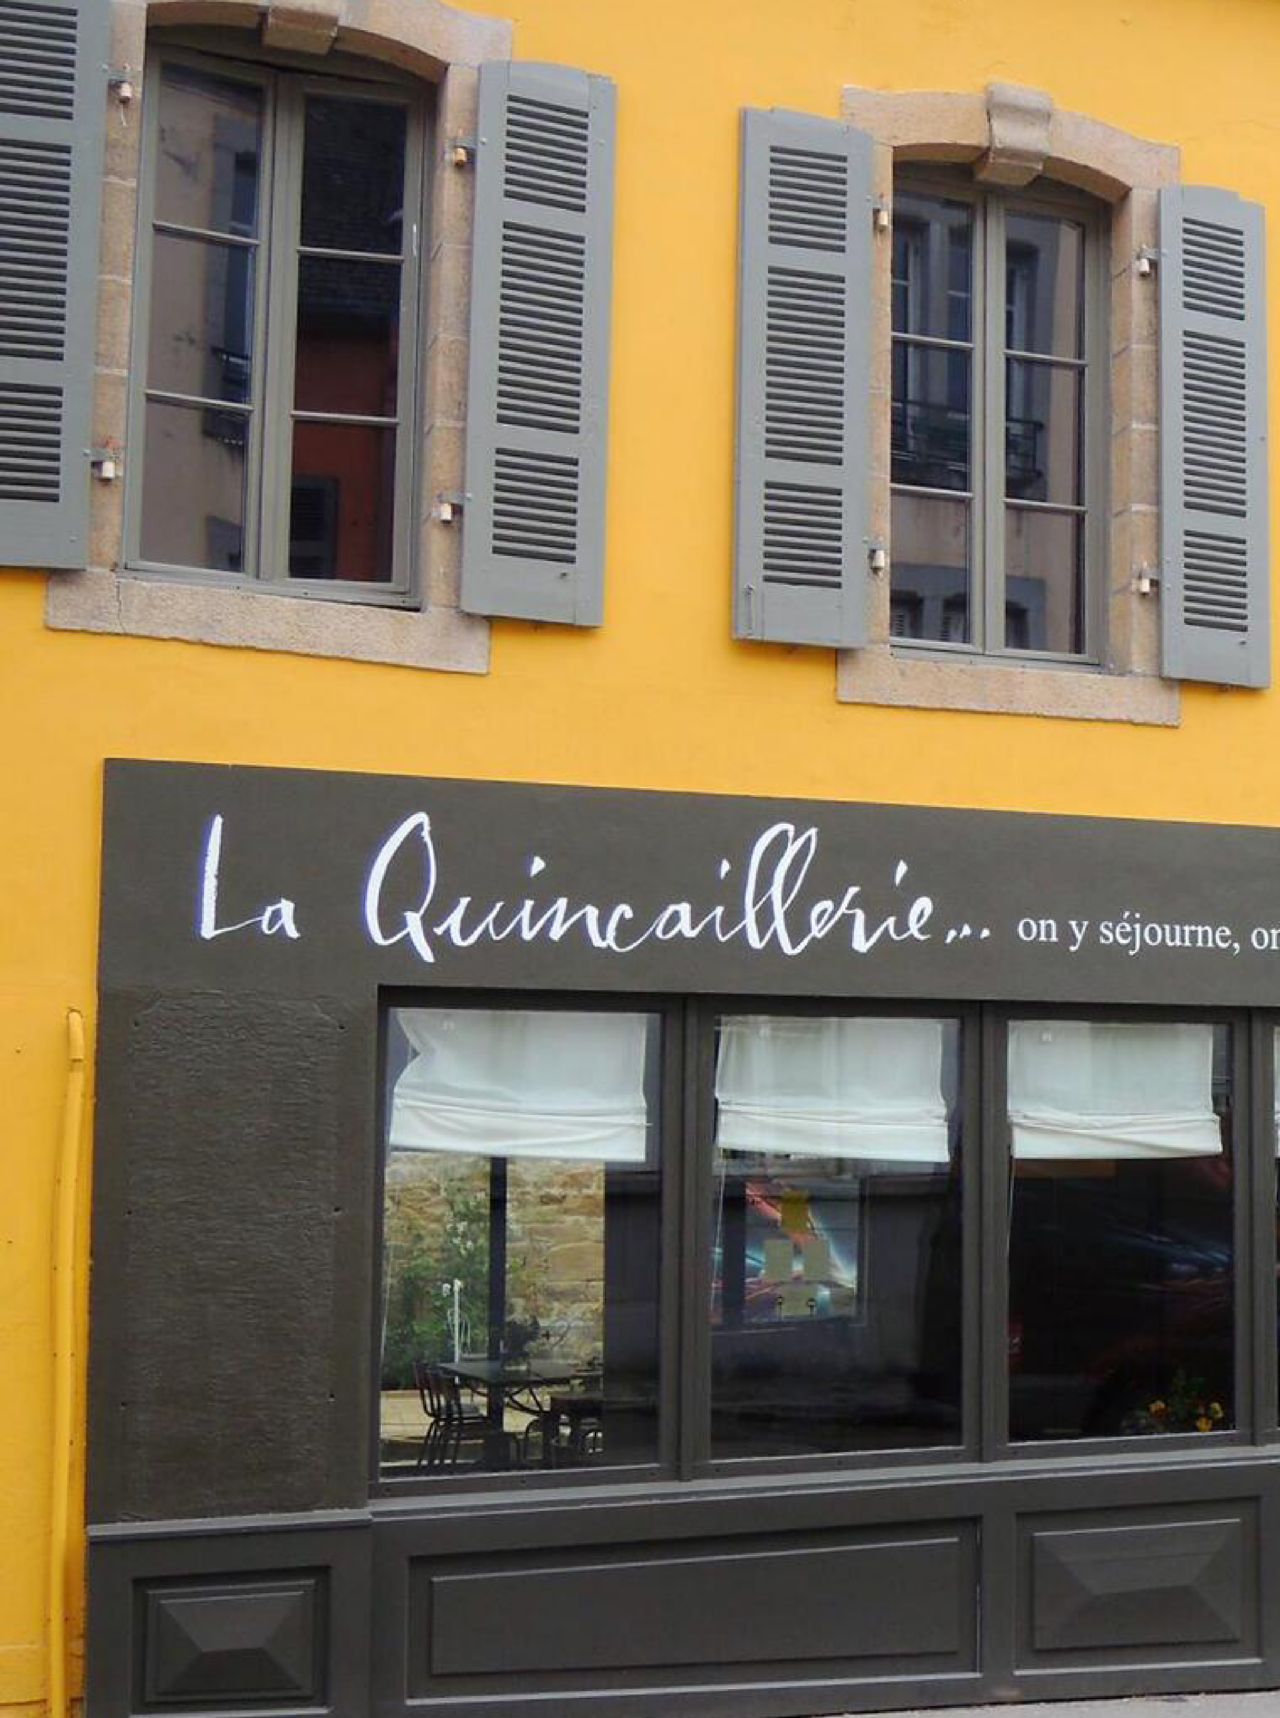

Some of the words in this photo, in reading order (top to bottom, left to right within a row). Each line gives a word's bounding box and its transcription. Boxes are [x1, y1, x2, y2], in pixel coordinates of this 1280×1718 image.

[200, 814, 300, 941] La
[1016, 917, 1059, 943] on
[1068, 919, 1089, 953] y
[1099, 910, 1241, 956] séjourne,
